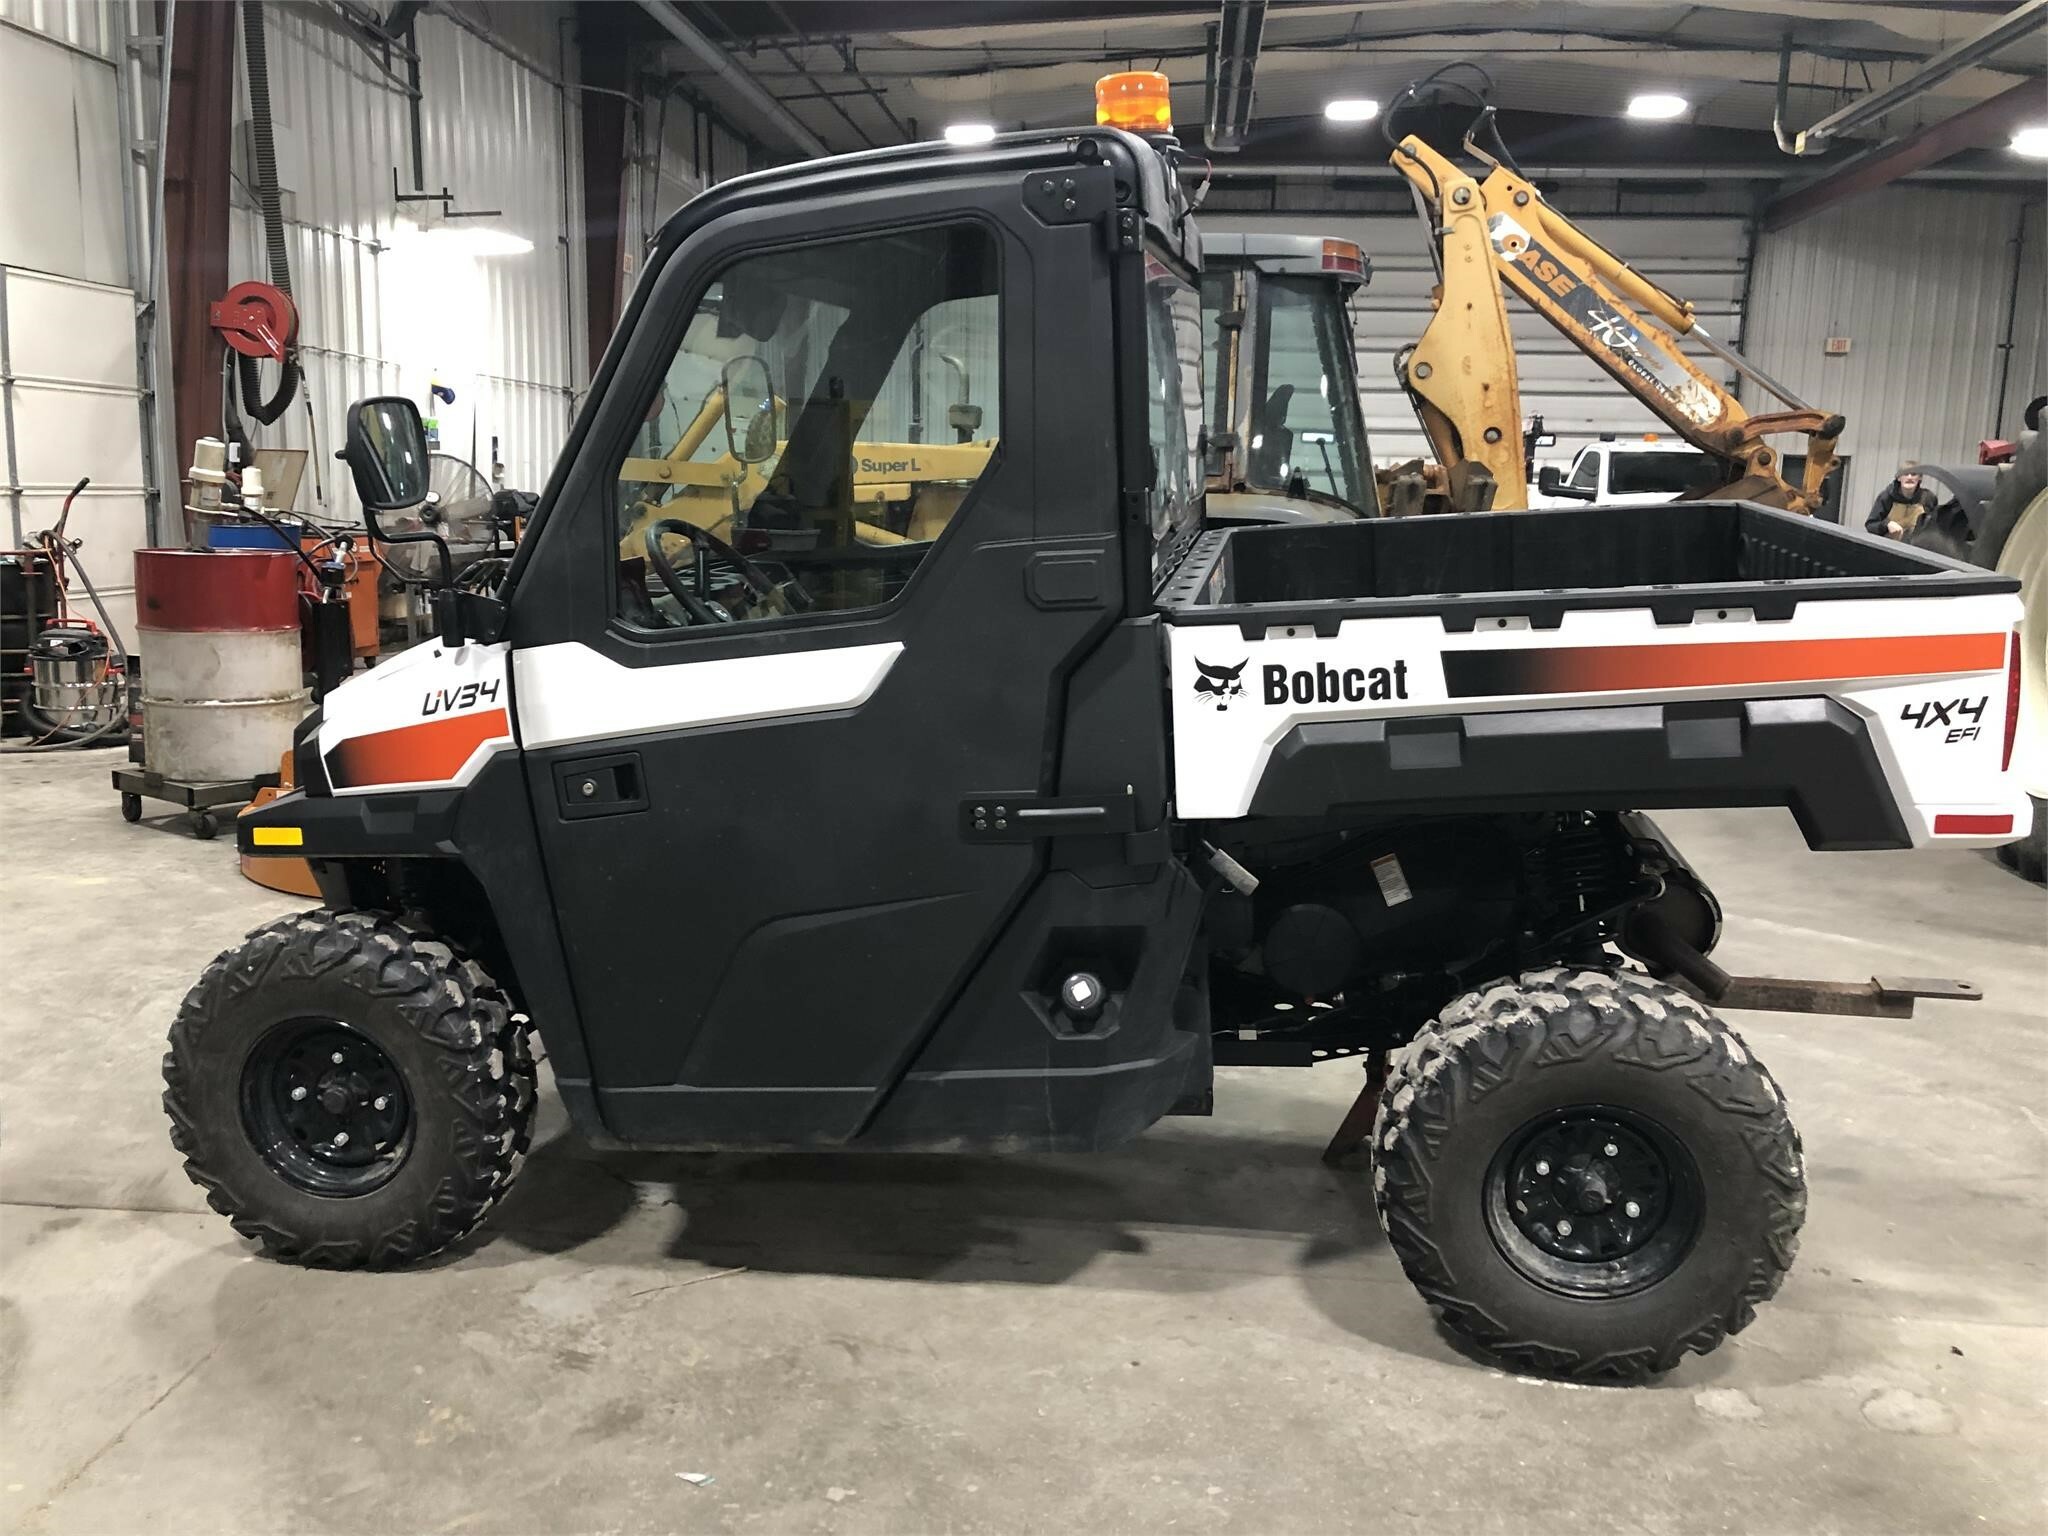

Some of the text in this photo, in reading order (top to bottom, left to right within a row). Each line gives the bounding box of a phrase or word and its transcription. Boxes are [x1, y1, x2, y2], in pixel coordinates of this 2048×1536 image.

[861, 458, 921, 474] Super L
[422, 678, 500, 716] UV34
[1263, 659, 1408, 705] Bobcat
[1900, 696, 1989, 729] 4X4
[1944, 726, 1981, 744] EFI
